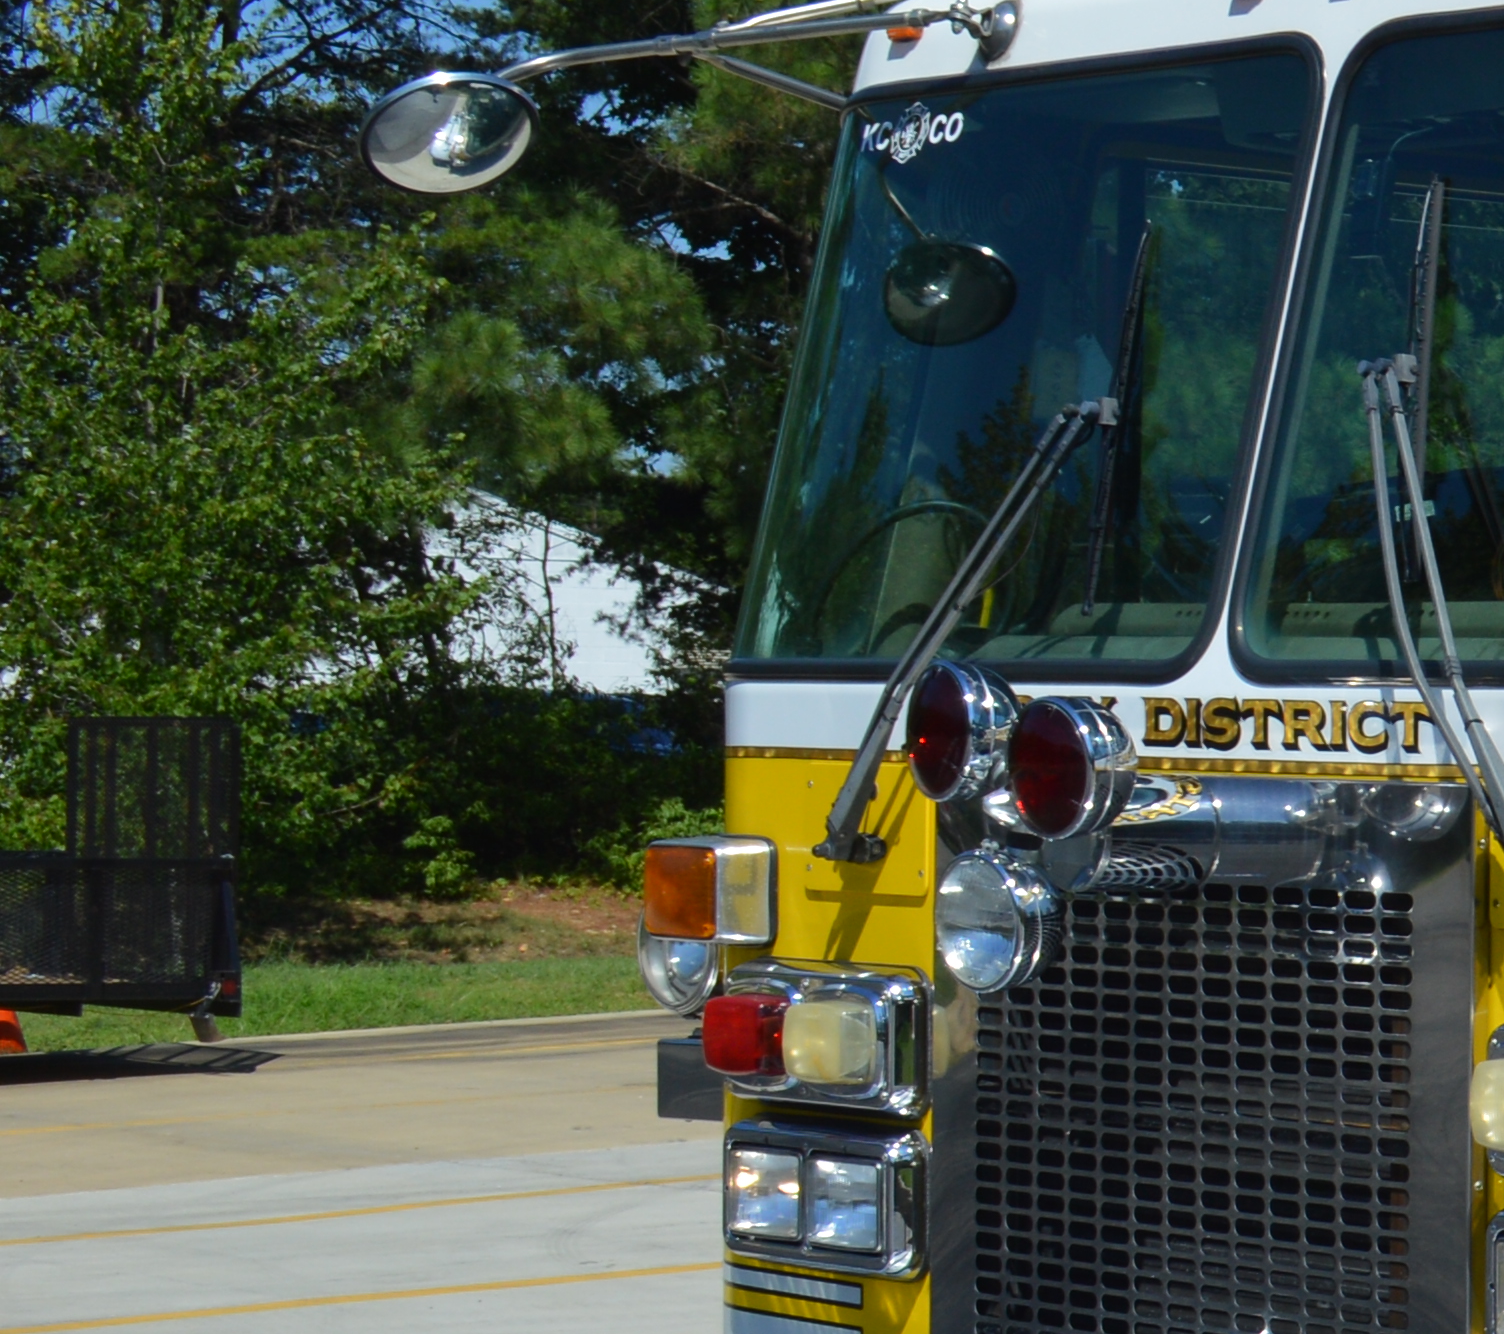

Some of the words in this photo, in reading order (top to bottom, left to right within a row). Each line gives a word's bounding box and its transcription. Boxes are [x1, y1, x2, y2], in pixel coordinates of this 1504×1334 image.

[860, 121, 893, 152] KC
[928, 111, 965, 145] CO
[1142, 696, 1440, 755] DISTRICT
